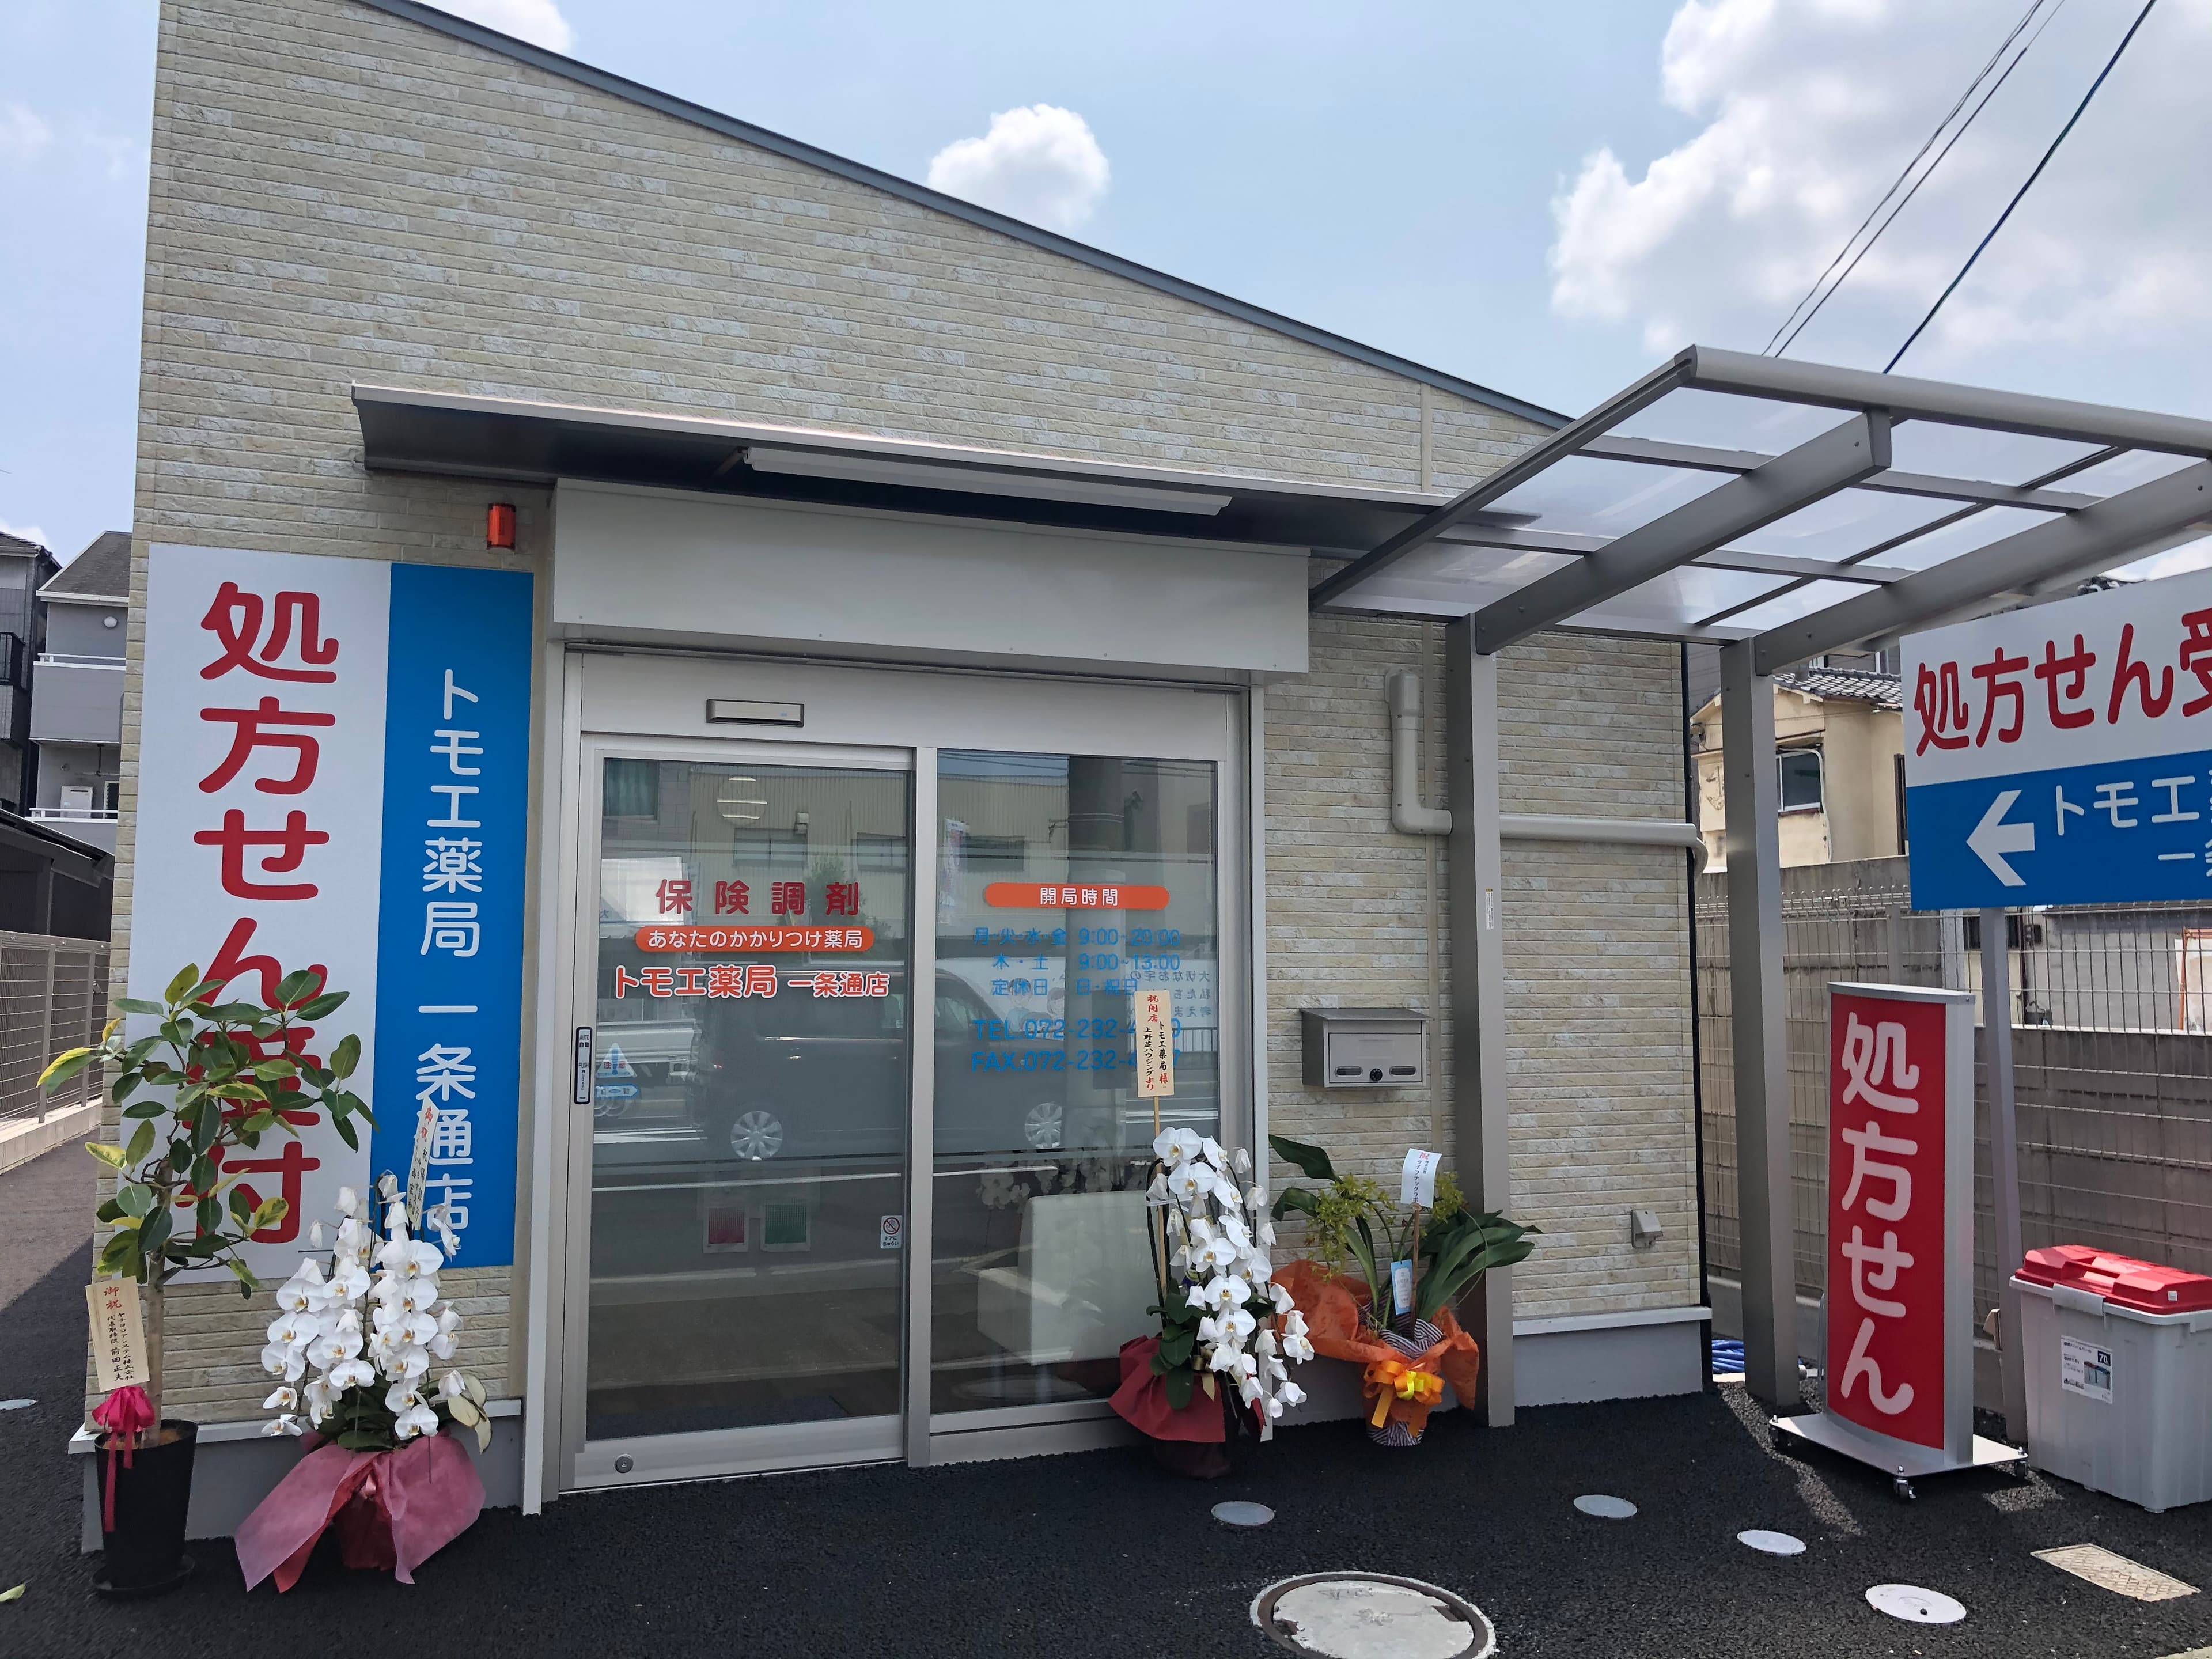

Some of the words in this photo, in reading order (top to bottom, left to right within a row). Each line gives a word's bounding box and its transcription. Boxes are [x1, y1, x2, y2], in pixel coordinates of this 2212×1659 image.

[421, 669, 483, 957] トモエ薬局
[2056, 768, 2212, 836] トモエ
[2158, 839, 2212, 877] 一
[656, 879, 859, 915] 保険調剤
[1040, 888, 1119, 906] 開局時間
[649, 930, 862, 949] あなたのかかりつけ薬局
[974, 927, 1067, 945] 月・火・水・金
[616, 965, 778, 999] トモエ薬局
[787, 972, 890, 998] 一条通店
[991, 978, 1048, 996] 定休日
[1147, 995, 1160, 1022] 祝開店
[1840, 1012, 1919, 1415] 処方せん
[104, 1286, 122, 1310] 御祝
